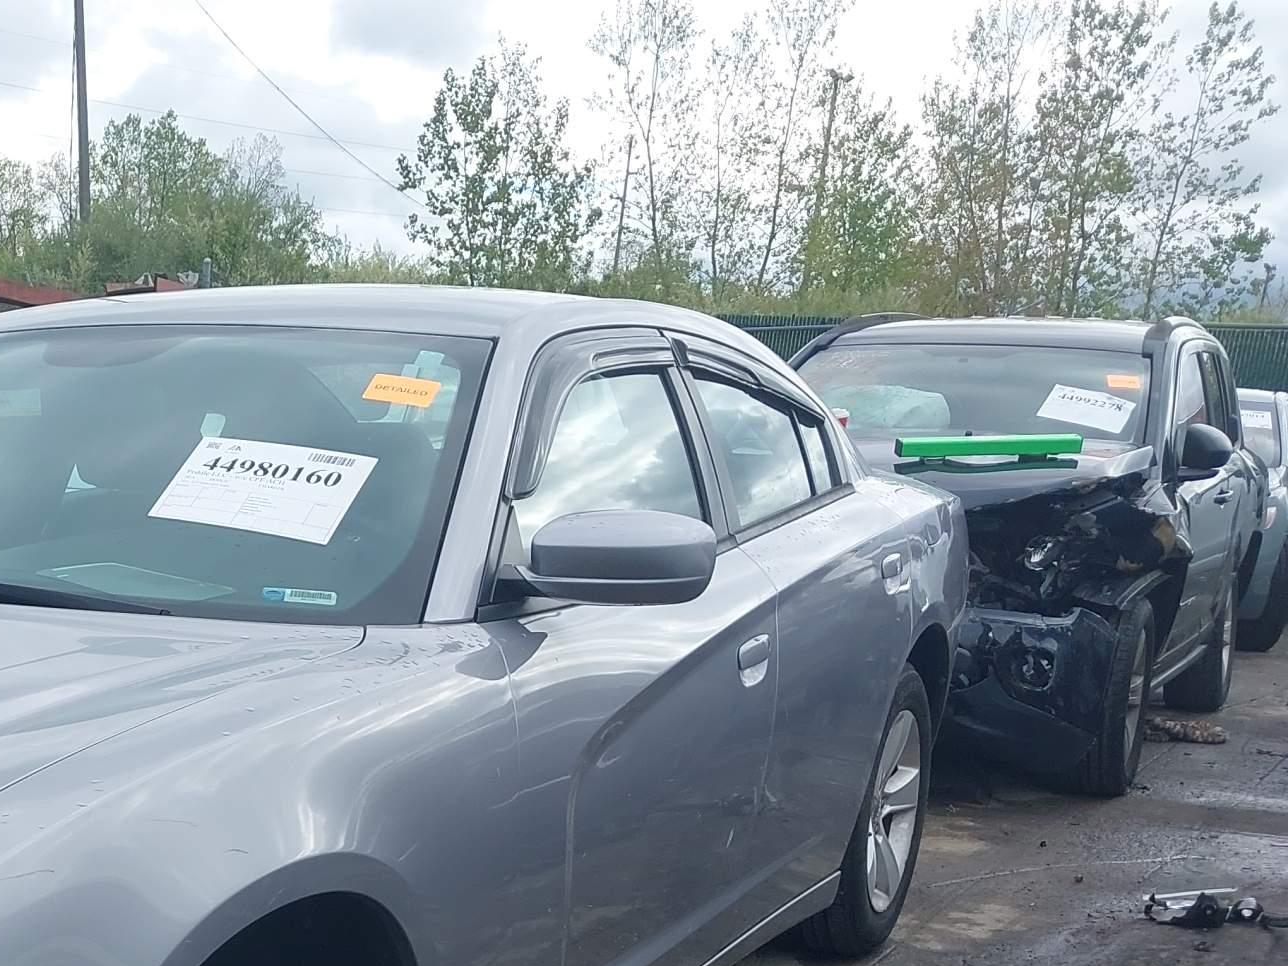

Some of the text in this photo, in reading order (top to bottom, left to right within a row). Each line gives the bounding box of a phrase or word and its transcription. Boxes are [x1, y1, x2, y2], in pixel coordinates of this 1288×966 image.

[374, 383, 429, 397] DETAILED
[1057, 393, 1124, 412] 44992278
[203, 456, 343, 488] 44980160
